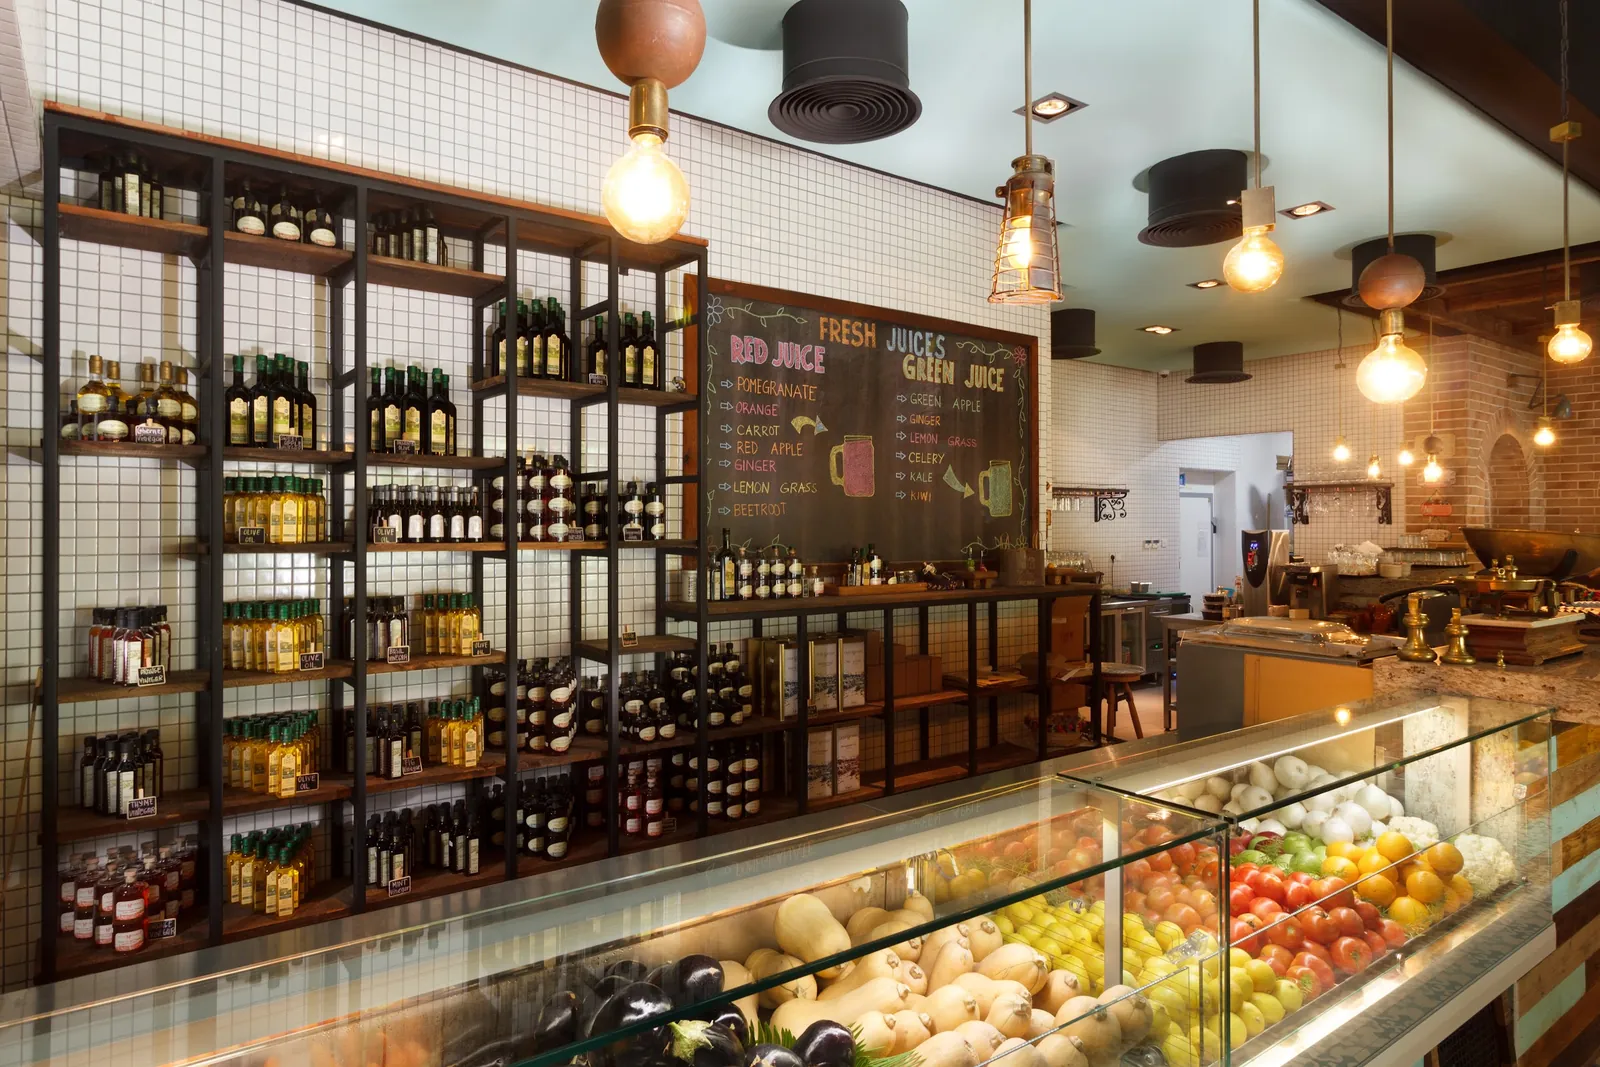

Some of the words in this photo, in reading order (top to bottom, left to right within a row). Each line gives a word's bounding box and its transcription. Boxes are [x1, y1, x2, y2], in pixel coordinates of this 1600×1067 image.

[818, 316, 877, 348] FRESH
[886, 327, 946, 360] JUICES
[730, 334, 769, 364] RED
[771, 341, 826, 374] JUICE
[902, 354, 954, 385] GREEN
[964, 364, 1005, 392] JUICE
[737, 376, 818, 401] POMEGRANATE
[735, 401, 779, 416] ORANGE
[910, 392, 942, 408] GREEN
[952, 398, 981, 413] APPLE
[910, 414, 941, 426] GINGER
[736, 424, 780, 437] CARROT
[910, 432, 938, 444] LEMON
[948, 436, 978, 448] GRASS
[736, 441, 759, 454] RED
[770, 442, 804, 456] APPLE
[734, 458, 776, 472] GINGER
[908, 452, 945, 464] CELERY
[910, 472, 933, 482] KALE
[733, 480, 770, 494] LEMON
[780, 482, 818, 494] GRASS
[910, 490, 932, 503] KIWI
[733, 502, 786, 517] BEETROOT
[302, 654, 320, 662] OLIVE
[131, 799, 154, 808] THYME
[392, 878, 408, 888] MINT
